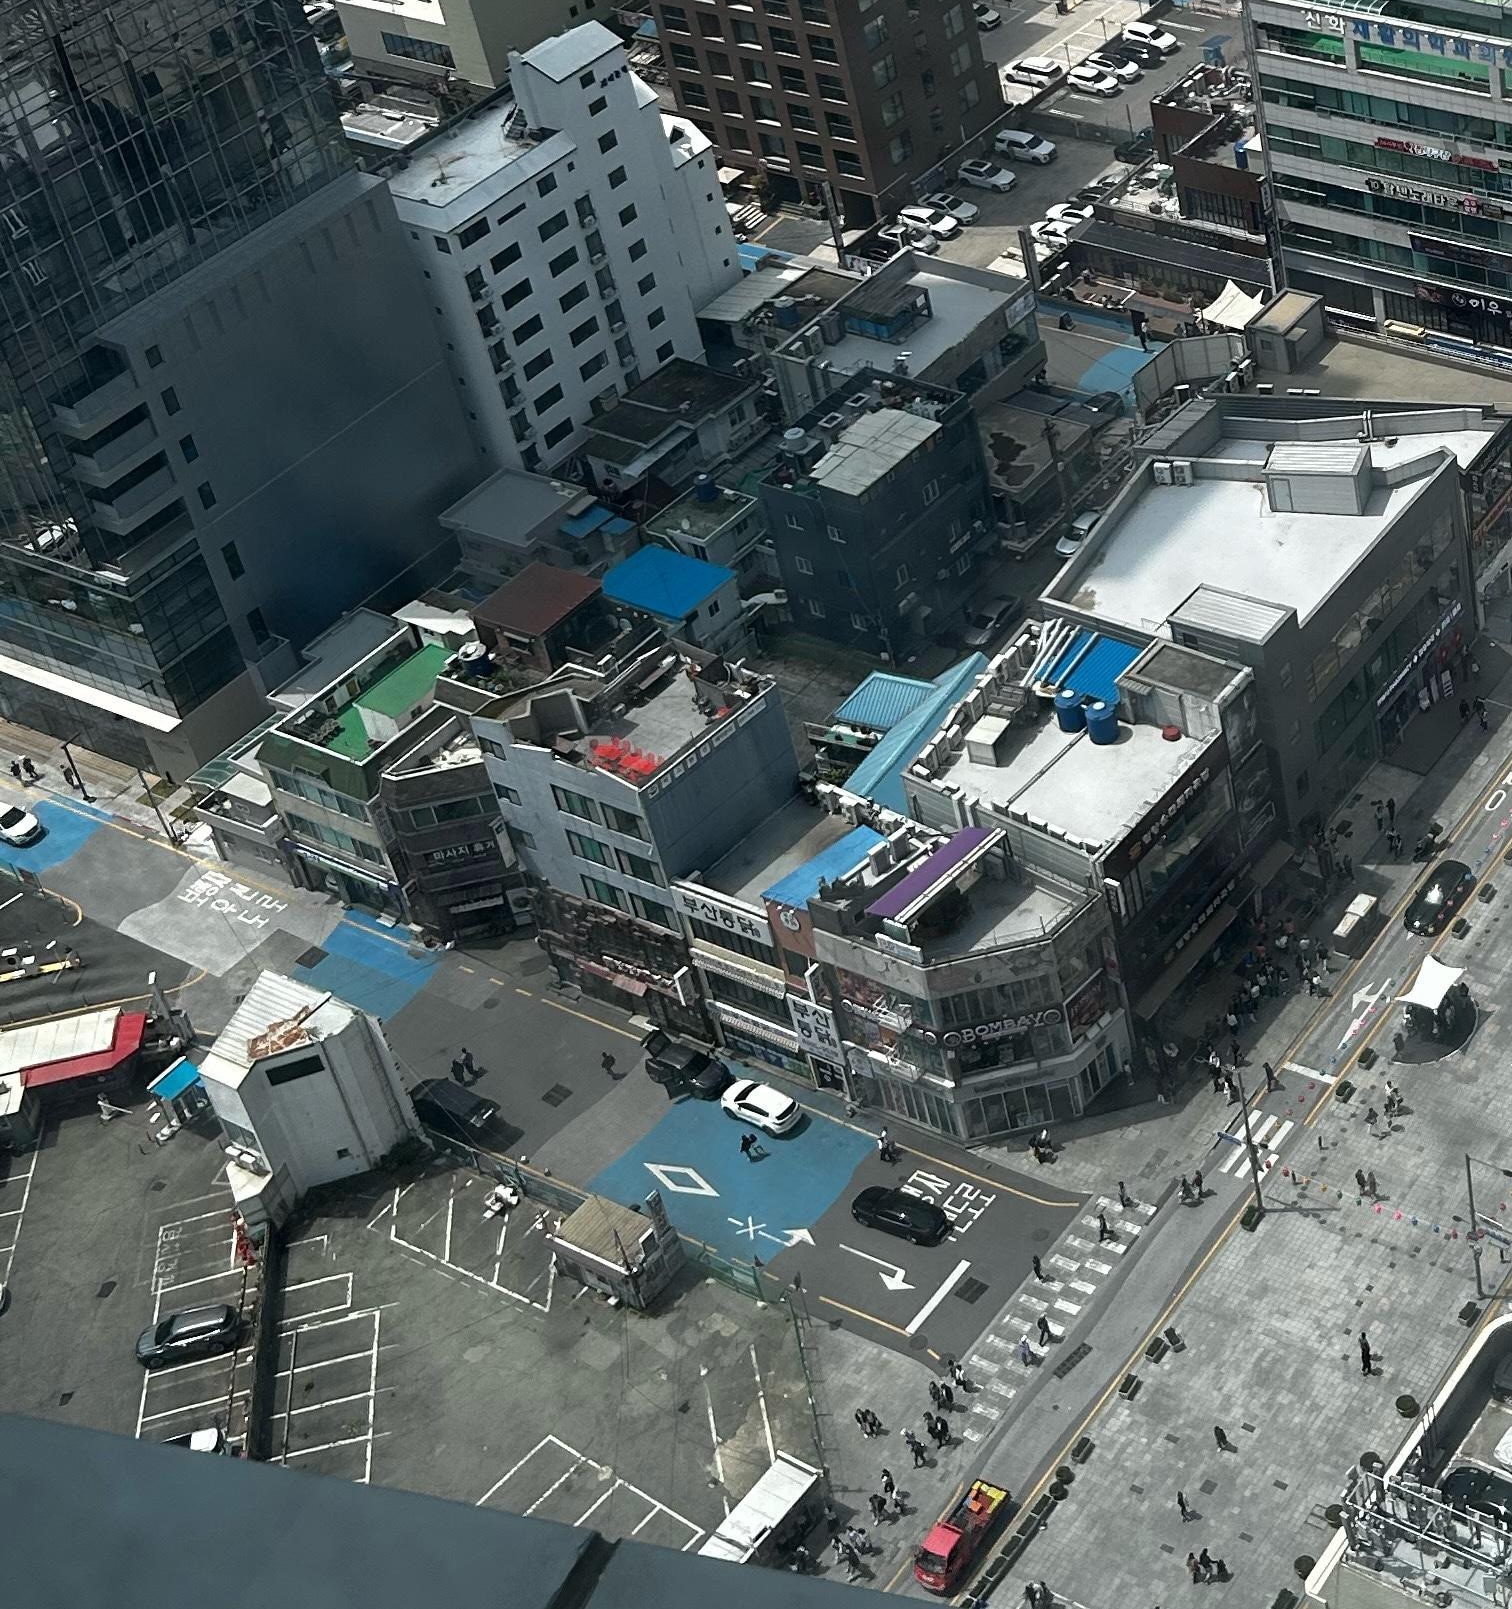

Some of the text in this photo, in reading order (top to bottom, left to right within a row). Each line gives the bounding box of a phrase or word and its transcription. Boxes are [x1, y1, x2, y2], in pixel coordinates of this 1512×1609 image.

[1301, 10, 1346, 35] 신화
[433, 845, 469, 860] 마사지
[178, 870, 232, 907] 보행자
[682, 894, 756, 935] 부산통닭
[793, 1000, 831, 1029] 부산
[961, 1011, 1045, 1043] BOMBAY
